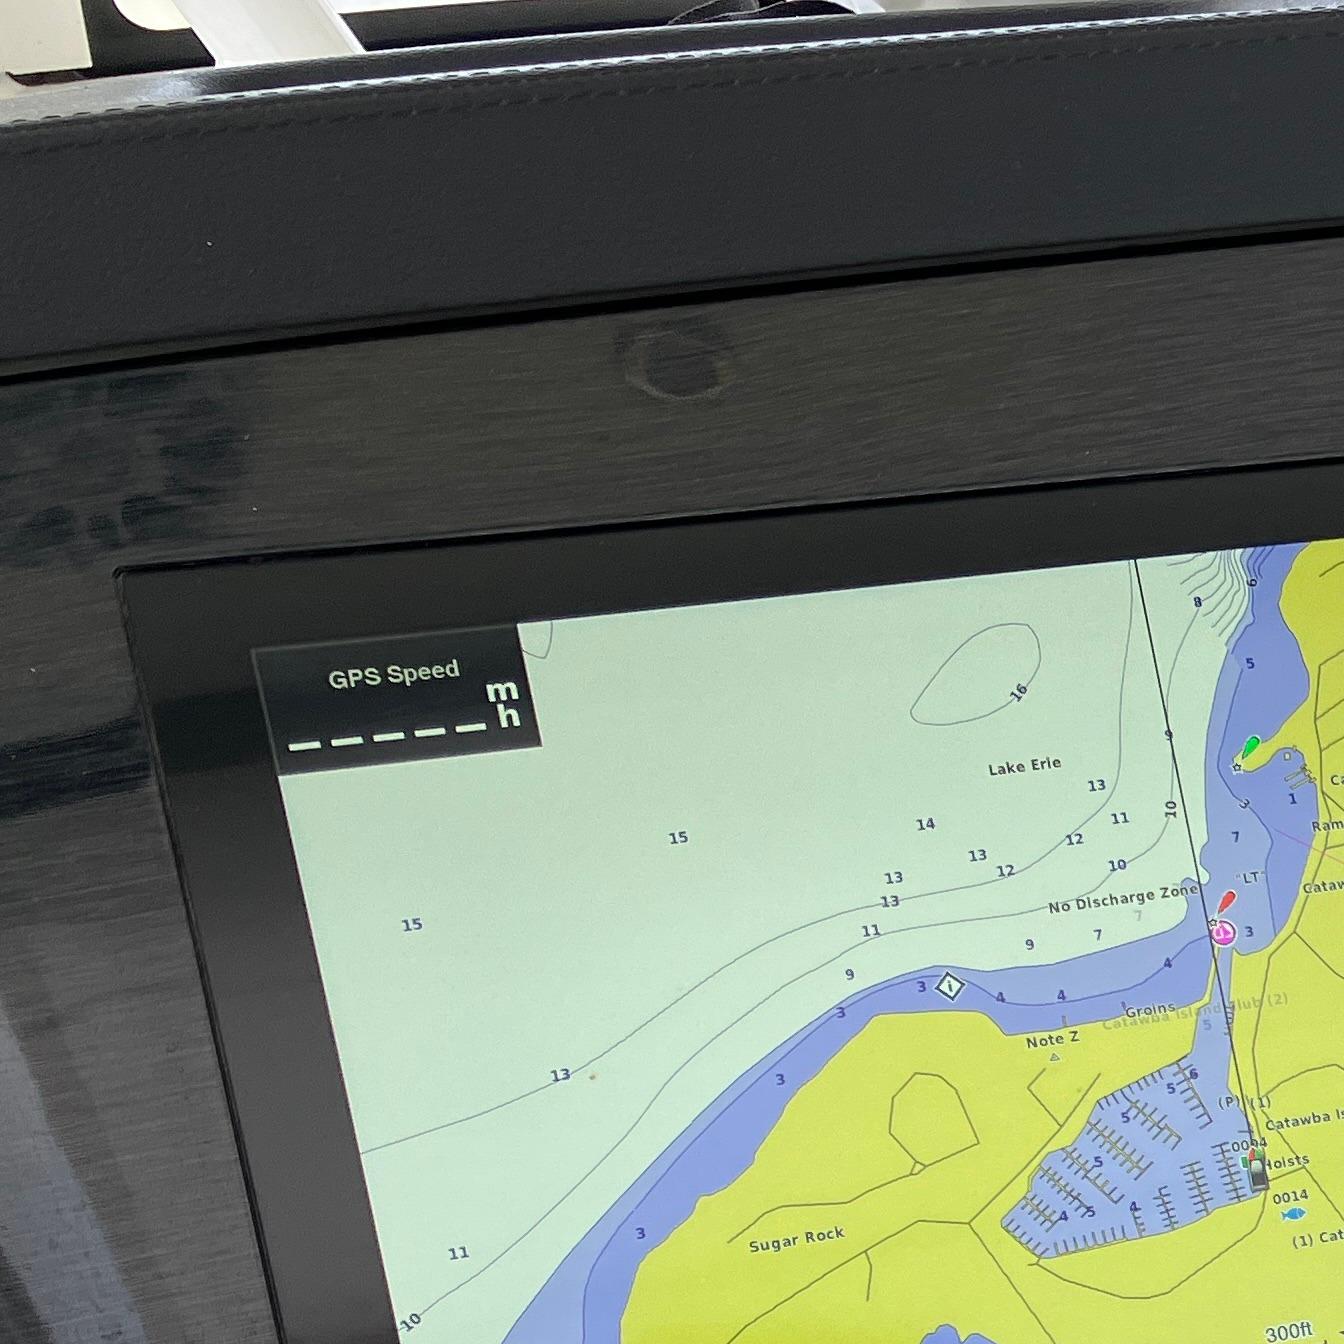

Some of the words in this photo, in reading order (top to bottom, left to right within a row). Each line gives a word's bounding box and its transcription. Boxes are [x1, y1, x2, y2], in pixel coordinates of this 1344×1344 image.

[328, 667, 381, 689] GPS
[387, 659, 460, 687] Speed
[1010, 683, 1028, 702] 16
[989, 760, 1025, 777] Lake
[1031, 757, 1062, 772] Erie
[916, 817, 936, 832] 14
[669, 830, 689, 846] 15
[1065, 833, 1085, 846] 12
[1048, 901, 1071, 914] No
[1076, 888, 1156, 913] Discharge
[1160, 884, 1199, 900] Zone
[401, 916, 424, 934] 15
[1125, 1002, 1176, 1019] Groins
[1026, 1032, 1064, 1049] Note
[1070, 1031, 1080, 1043] Z
[1265, 1112, 1331, 1130] Catawba
[1273, 1189, 1308, 1205] 0014
[749, 1233, 798, 1254] Sugar
[805, 1226, 845, 1244] Rock
[1292, 1233, 1313, 1249] (1)
[400, 1313, 422, 1333] 10
[1265, 1321, 1314, 1344] 300ft
